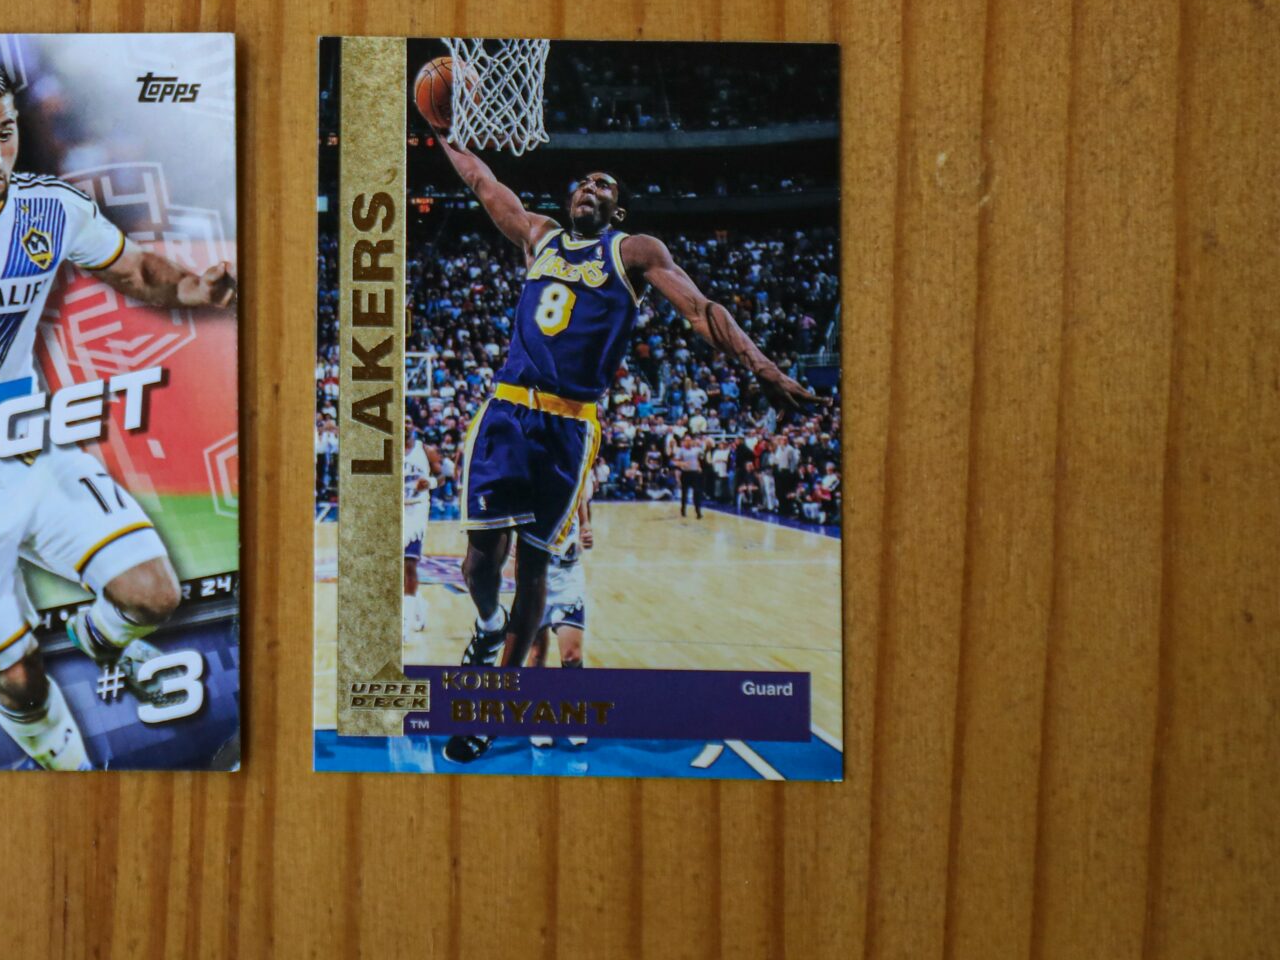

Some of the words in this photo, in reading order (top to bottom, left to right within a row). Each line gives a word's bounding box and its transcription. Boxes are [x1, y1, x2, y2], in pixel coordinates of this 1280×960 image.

[534, 282, 578, 337] 8
[351, 191, 396, 476] LAKERS
[200, 576, 232, 597] 24
[351, 682, 427, 695] UPPER
[442, 671, 521, 691] KOBE
[742, 681, 794, 696] Guard
[451, 699, 615, 725] BRYANT
